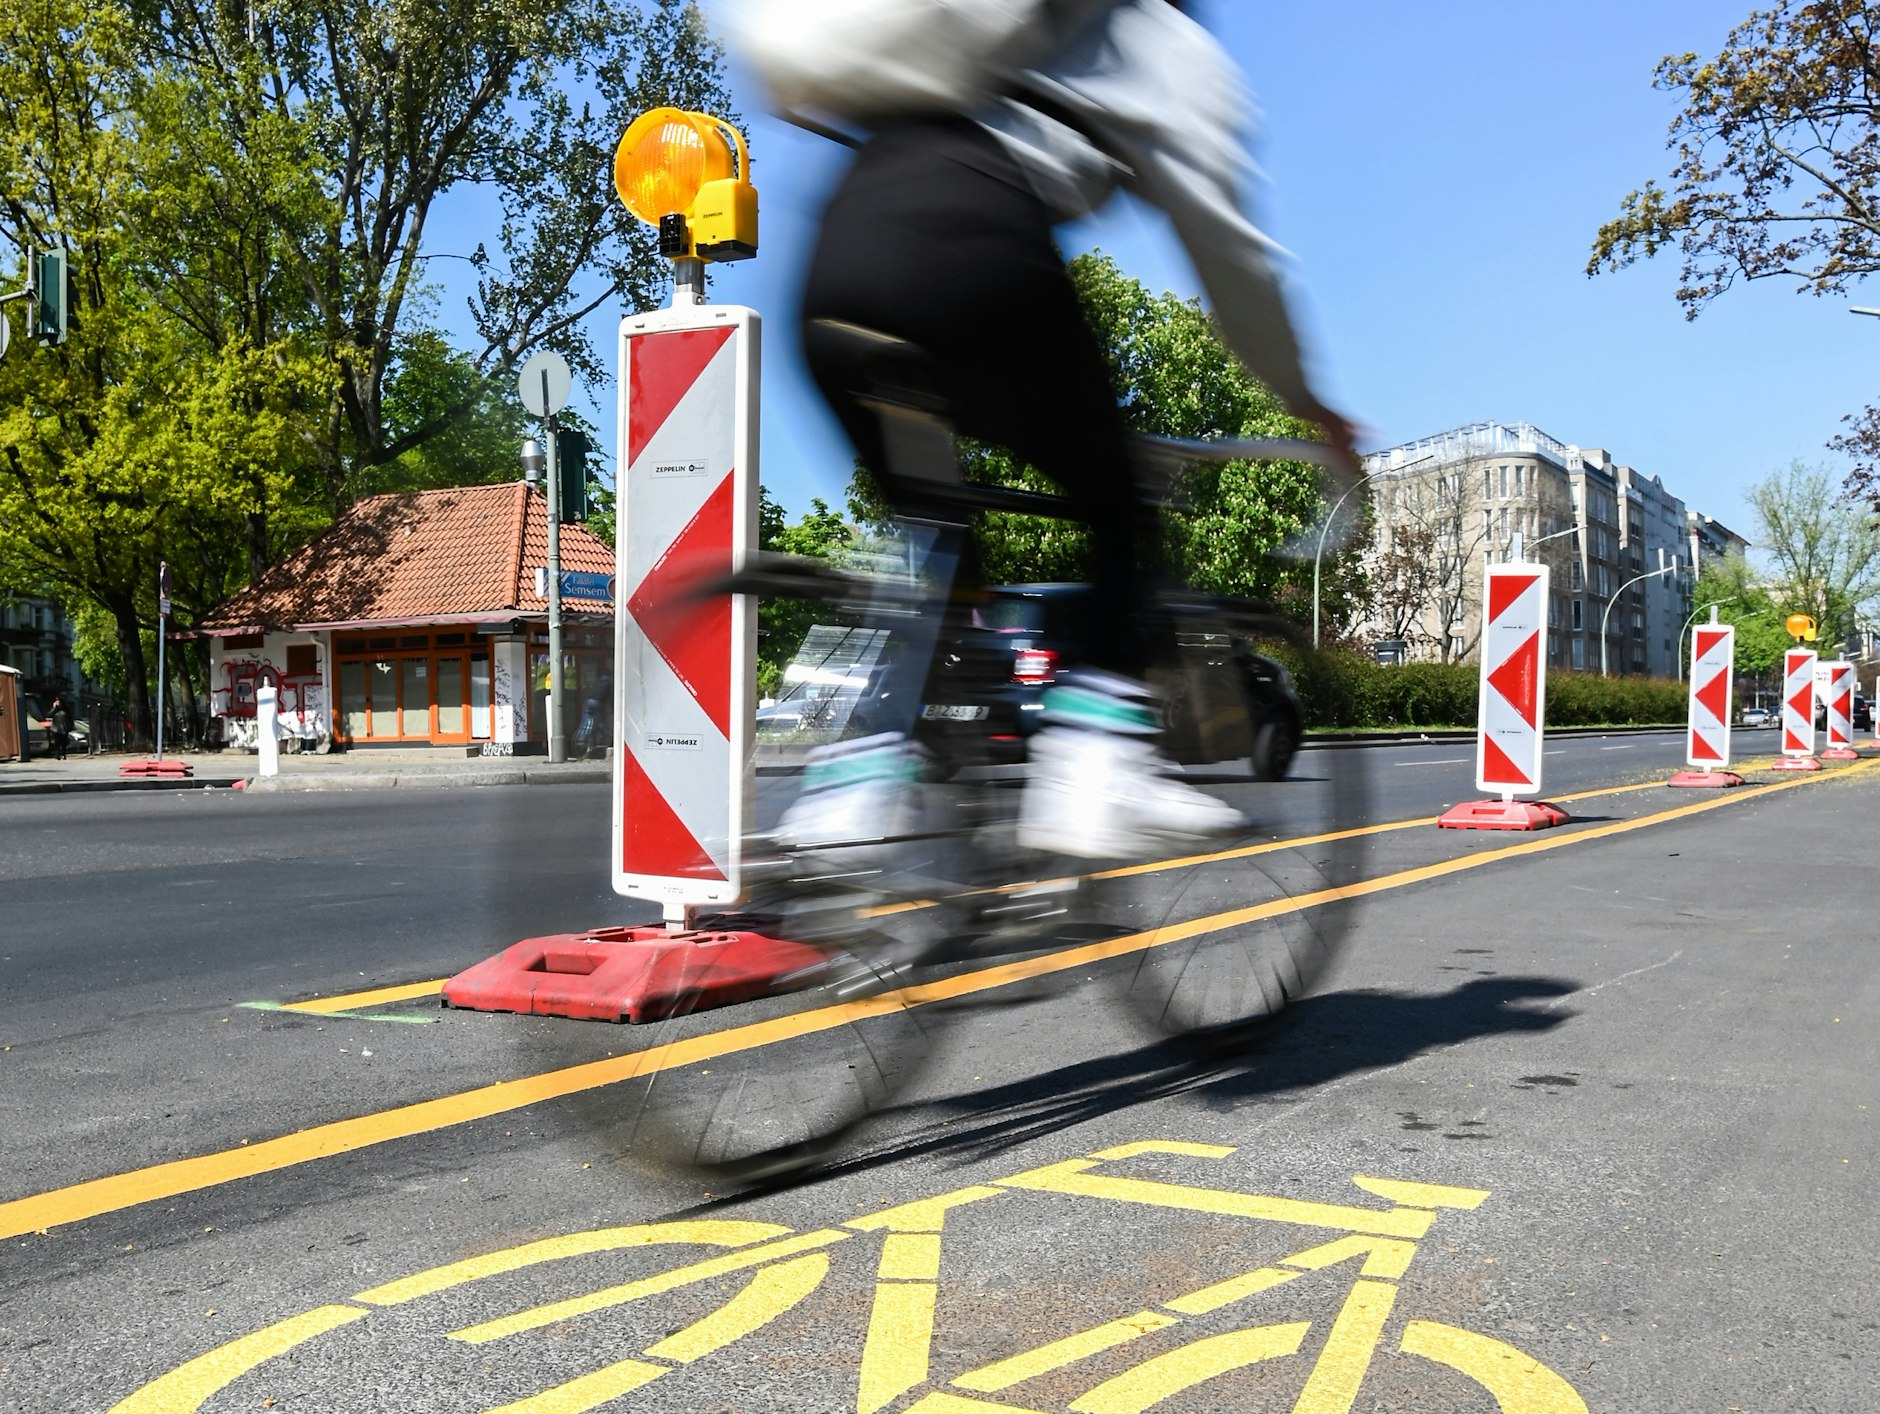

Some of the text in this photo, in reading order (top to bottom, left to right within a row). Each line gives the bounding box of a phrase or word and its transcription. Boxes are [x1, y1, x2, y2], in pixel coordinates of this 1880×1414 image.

[655, 465, 686, 473] ZEPPELIN
[564, 582, 606, 597] Semsem
[665, 738, 698, 746] ZEPPELIN
